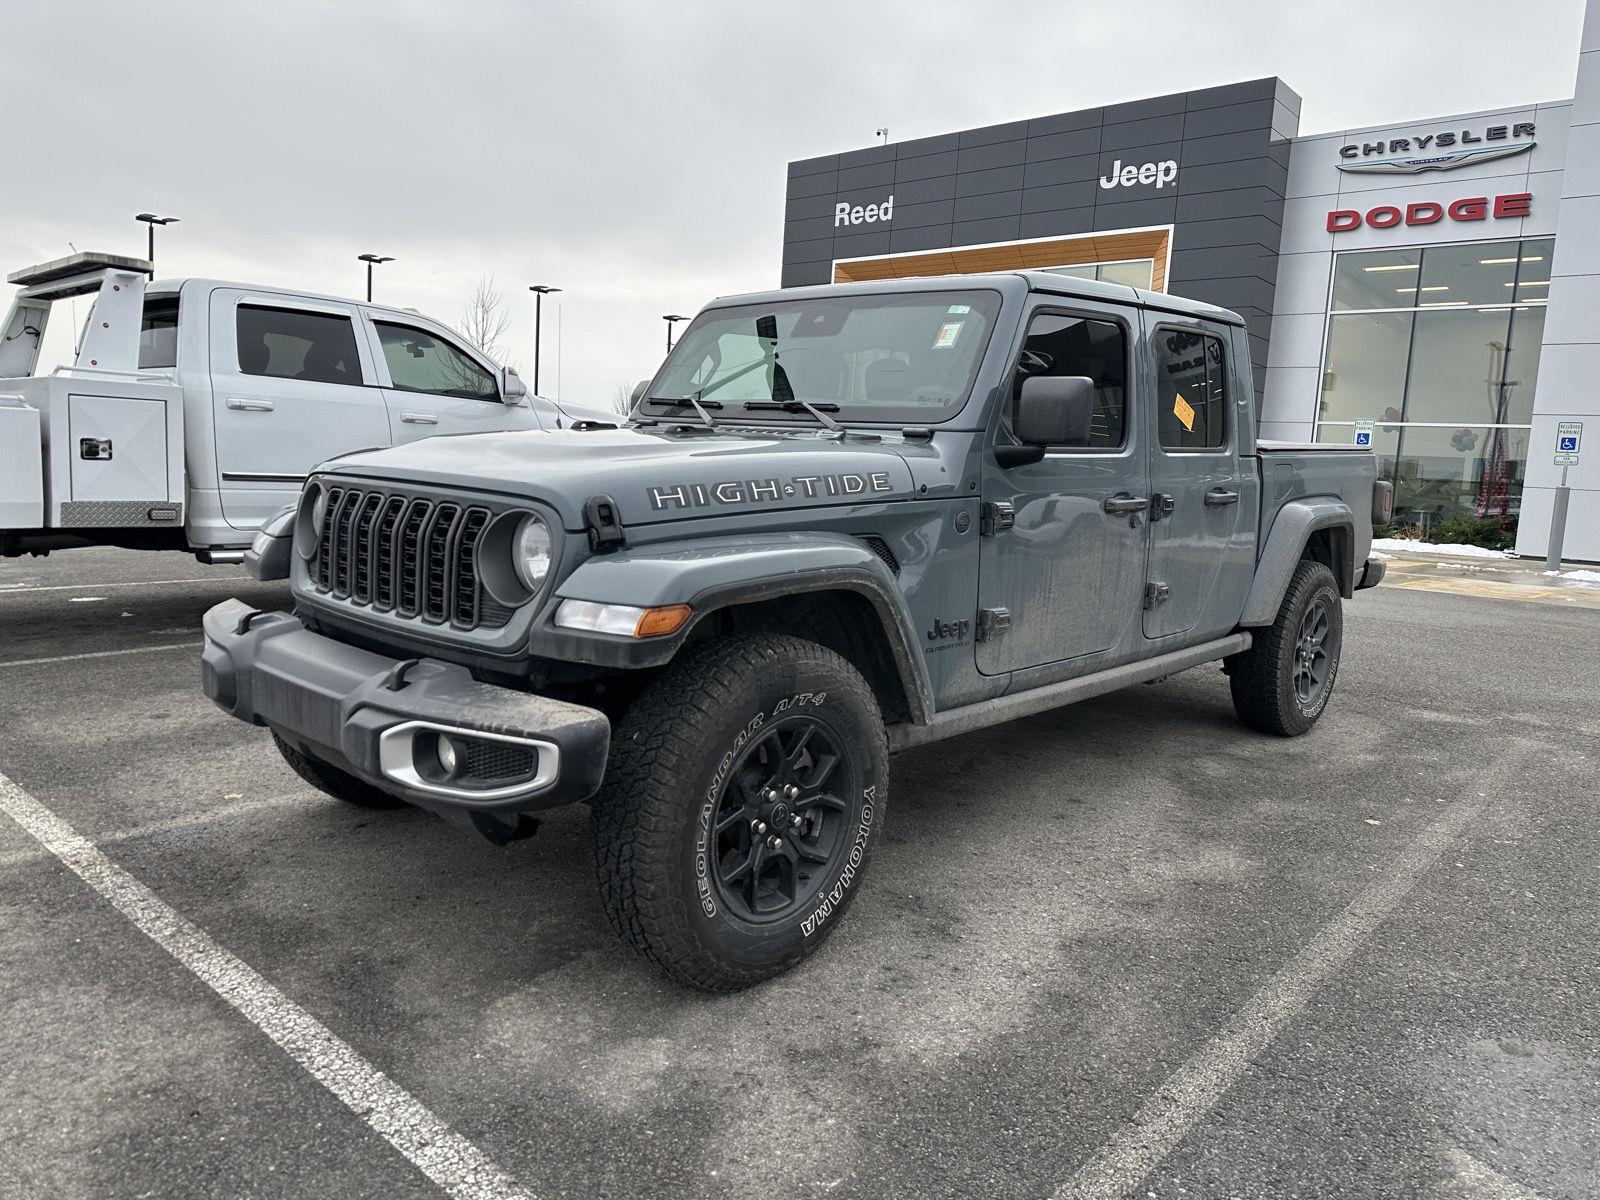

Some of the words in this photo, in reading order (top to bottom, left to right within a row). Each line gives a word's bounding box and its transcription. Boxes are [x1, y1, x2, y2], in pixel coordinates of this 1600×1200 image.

[1339, 122, 1536, 158] CHRYSLER
[1099, 159, 1178, 189] Jeep
[834, 196, 894, 227] Reed
[1326, 192, 1532, 233] DODGE
[645, 477, 783, 511] HIGH
[791, 471, 894, 498] TIDE
[927, 617, 970, 640] Jeep
[695, 712, 764, 918] GEOLANDAR
[772, 691, 827, 716] A/T4
[800, 785, 876, 937] YOKOHAMA
